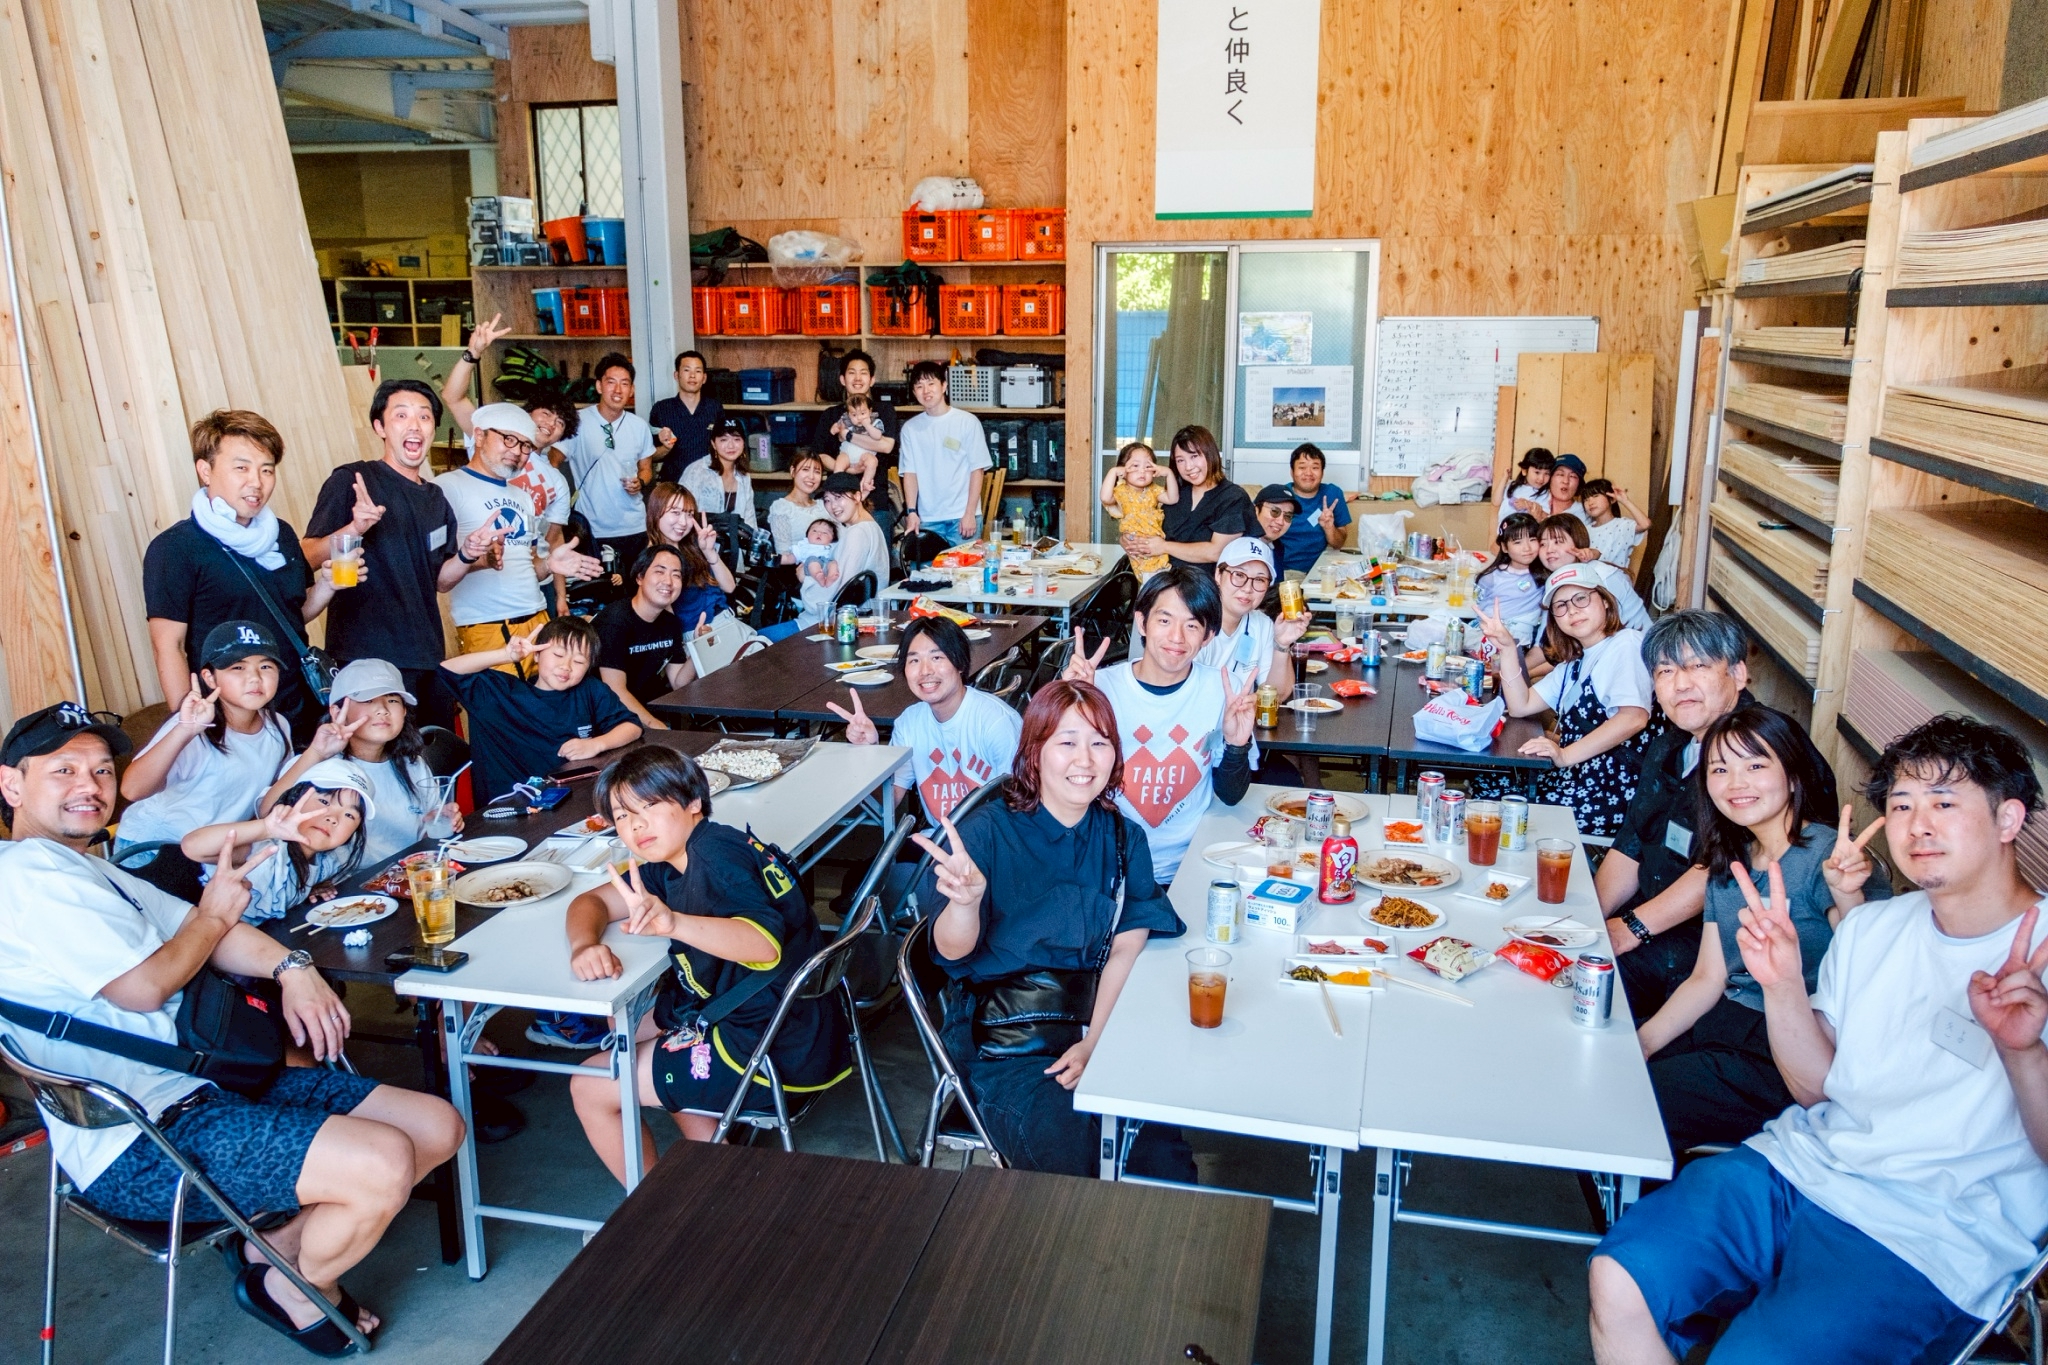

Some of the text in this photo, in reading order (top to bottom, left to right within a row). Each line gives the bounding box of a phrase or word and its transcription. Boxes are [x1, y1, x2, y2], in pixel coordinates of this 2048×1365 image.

[1224, 6, 1250, 125] と仲良く
[1250, 541, 1263, 556] LA
[237, 626, 261, 645] LA
[1132, 765, 1186, 785] TAKEI
[1140, 785, 1174, 805] FES
[1273, 916, 1287, 926] 100
